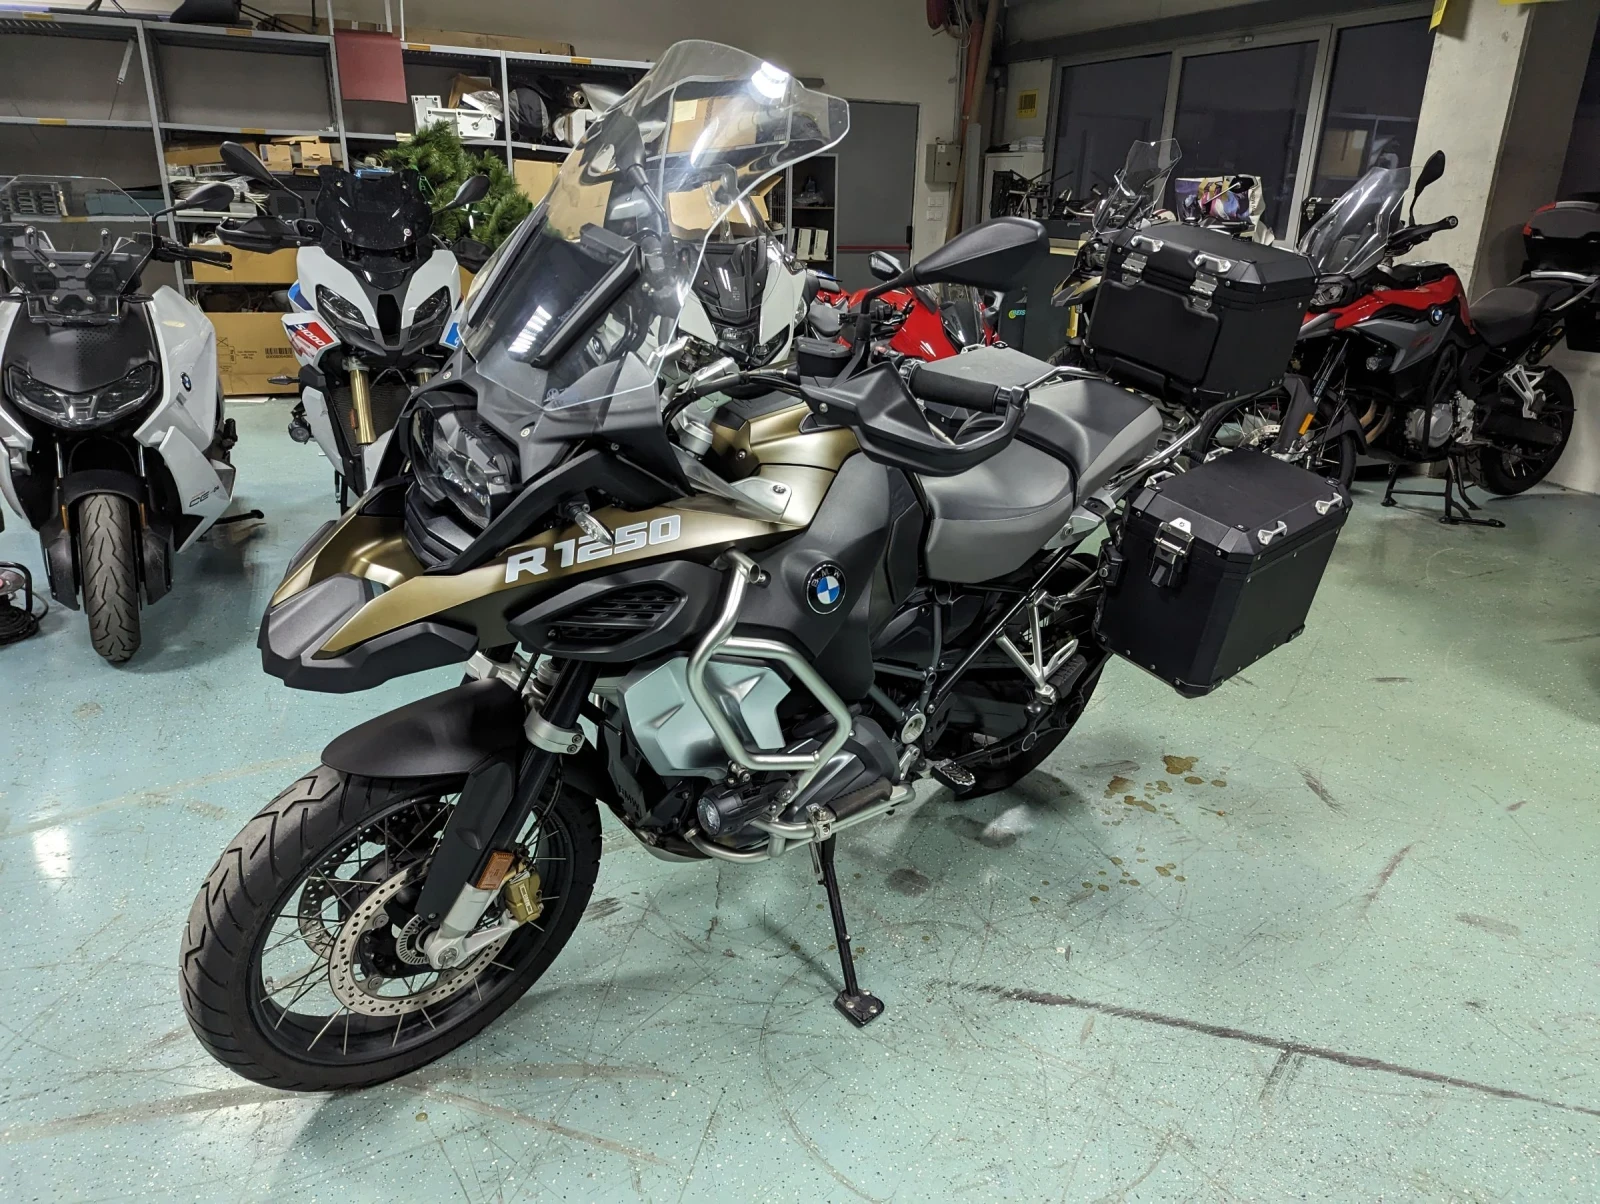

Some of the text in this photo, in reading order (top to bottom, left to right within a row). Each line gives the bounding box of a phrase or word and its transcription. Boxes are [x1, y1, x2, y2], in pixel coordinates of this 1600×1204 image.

[294, 324, 326, 346] S1000
[504, 514, 681, 584] R 1250
[811, 568, 841, 588] BMW
